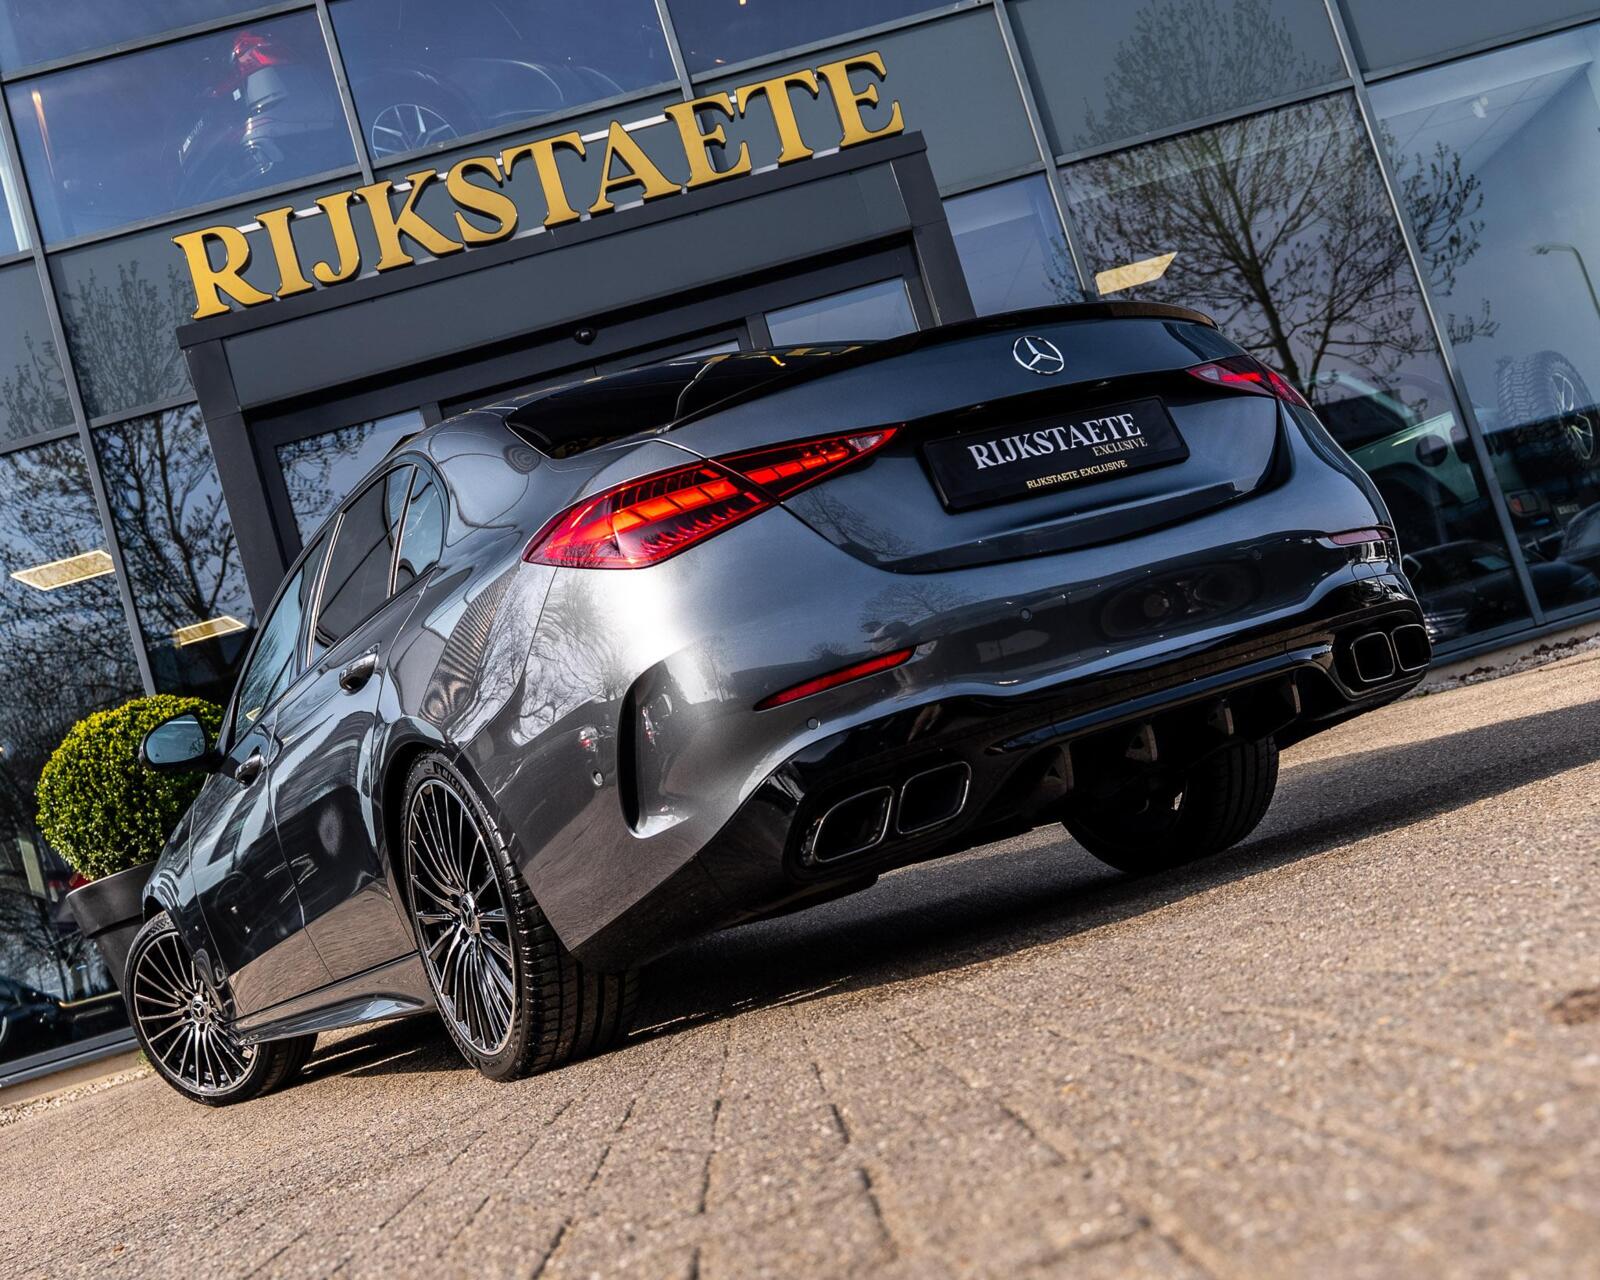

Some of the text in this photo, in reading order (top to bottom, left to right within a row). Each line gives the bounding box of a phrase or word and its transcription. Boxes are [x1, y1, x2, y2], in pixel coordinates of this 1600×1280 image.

[173, 51, 904, 319] RIJKSTAETE
[967, 413, 1141, 470] RIJKSTAETE
[1093, 437, 1148, 457] EXCLUSIVE
[1026, 460, 1128, 489] RIJKSTAETE EXCLUSIVE
